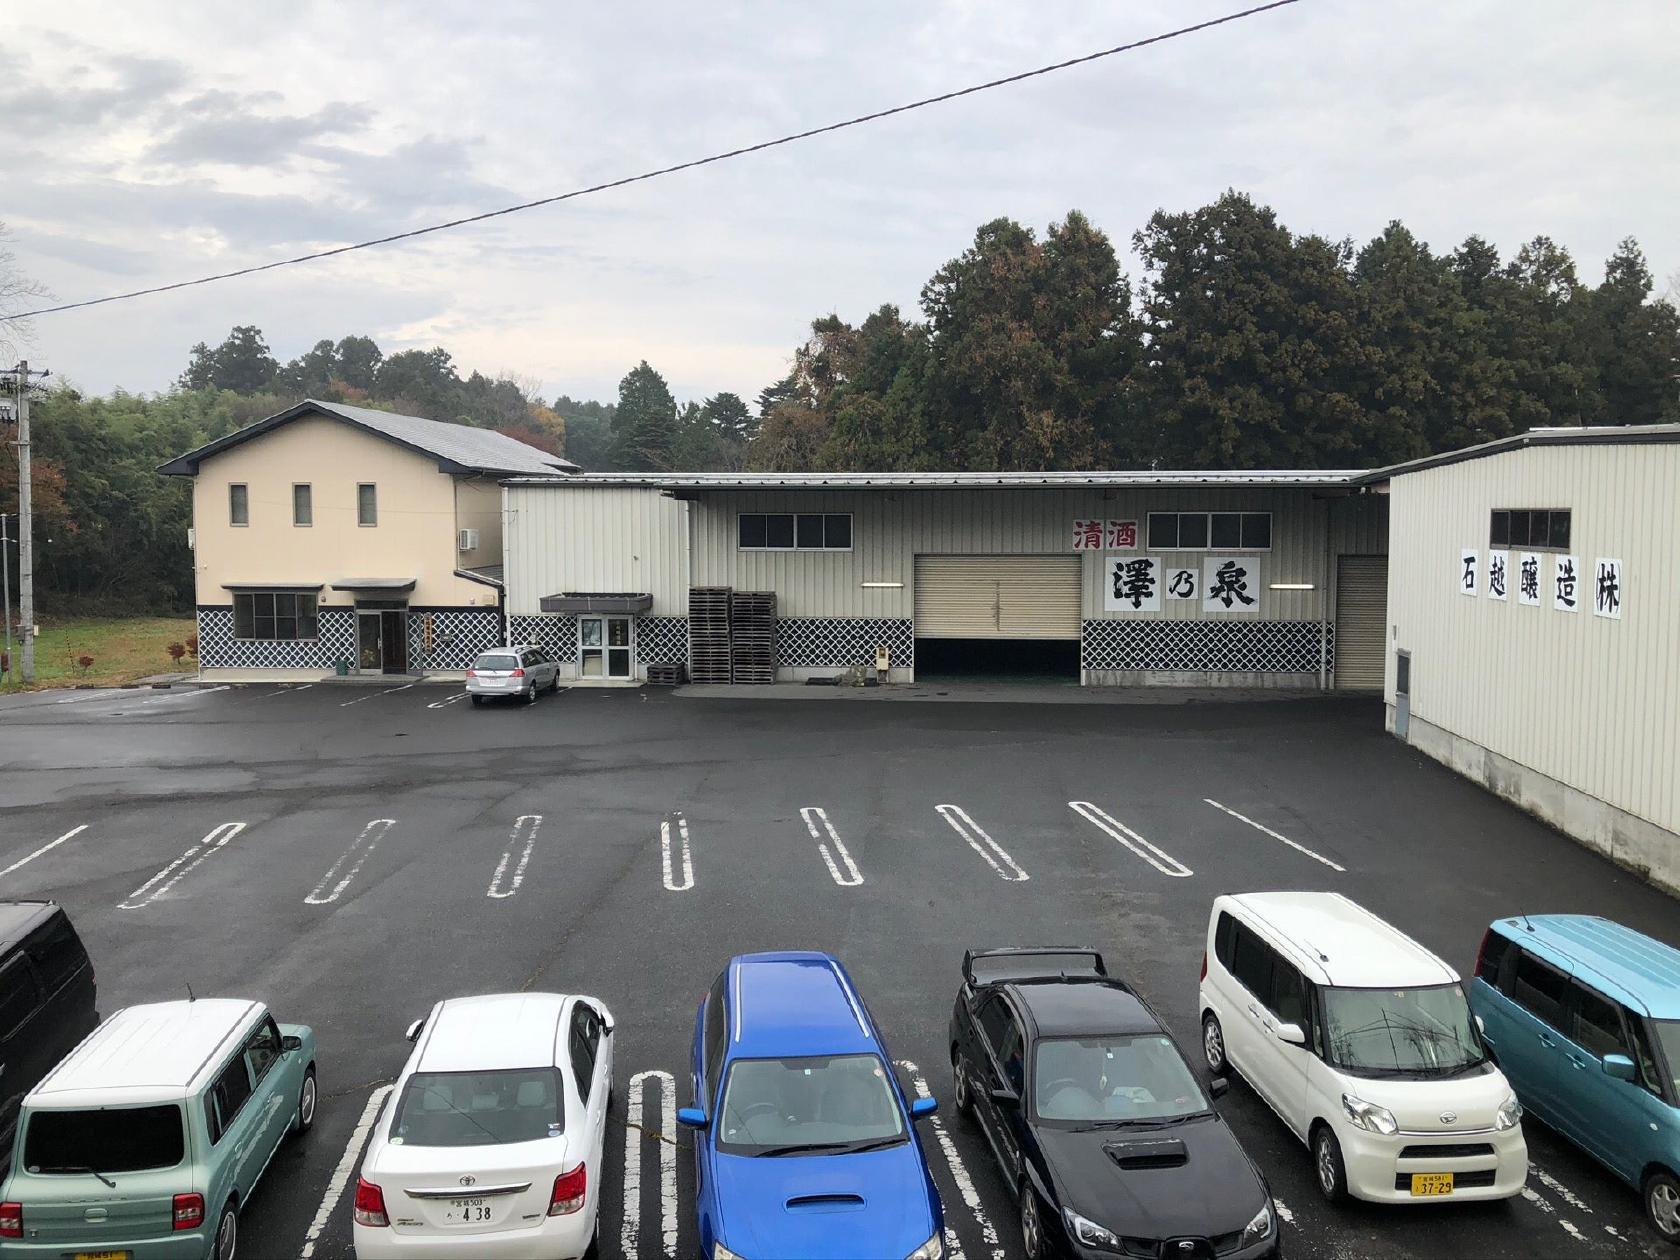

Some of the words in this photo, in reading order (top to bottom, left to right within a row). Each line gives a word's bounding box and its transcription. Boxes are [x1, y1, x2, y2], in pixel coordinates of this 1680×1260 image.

[1074, 520, 1136, 549] 清酒
[1112, 558, 1257, 609] 澤乃泉
[1421, 1182, 1451, 1193] 37-29
